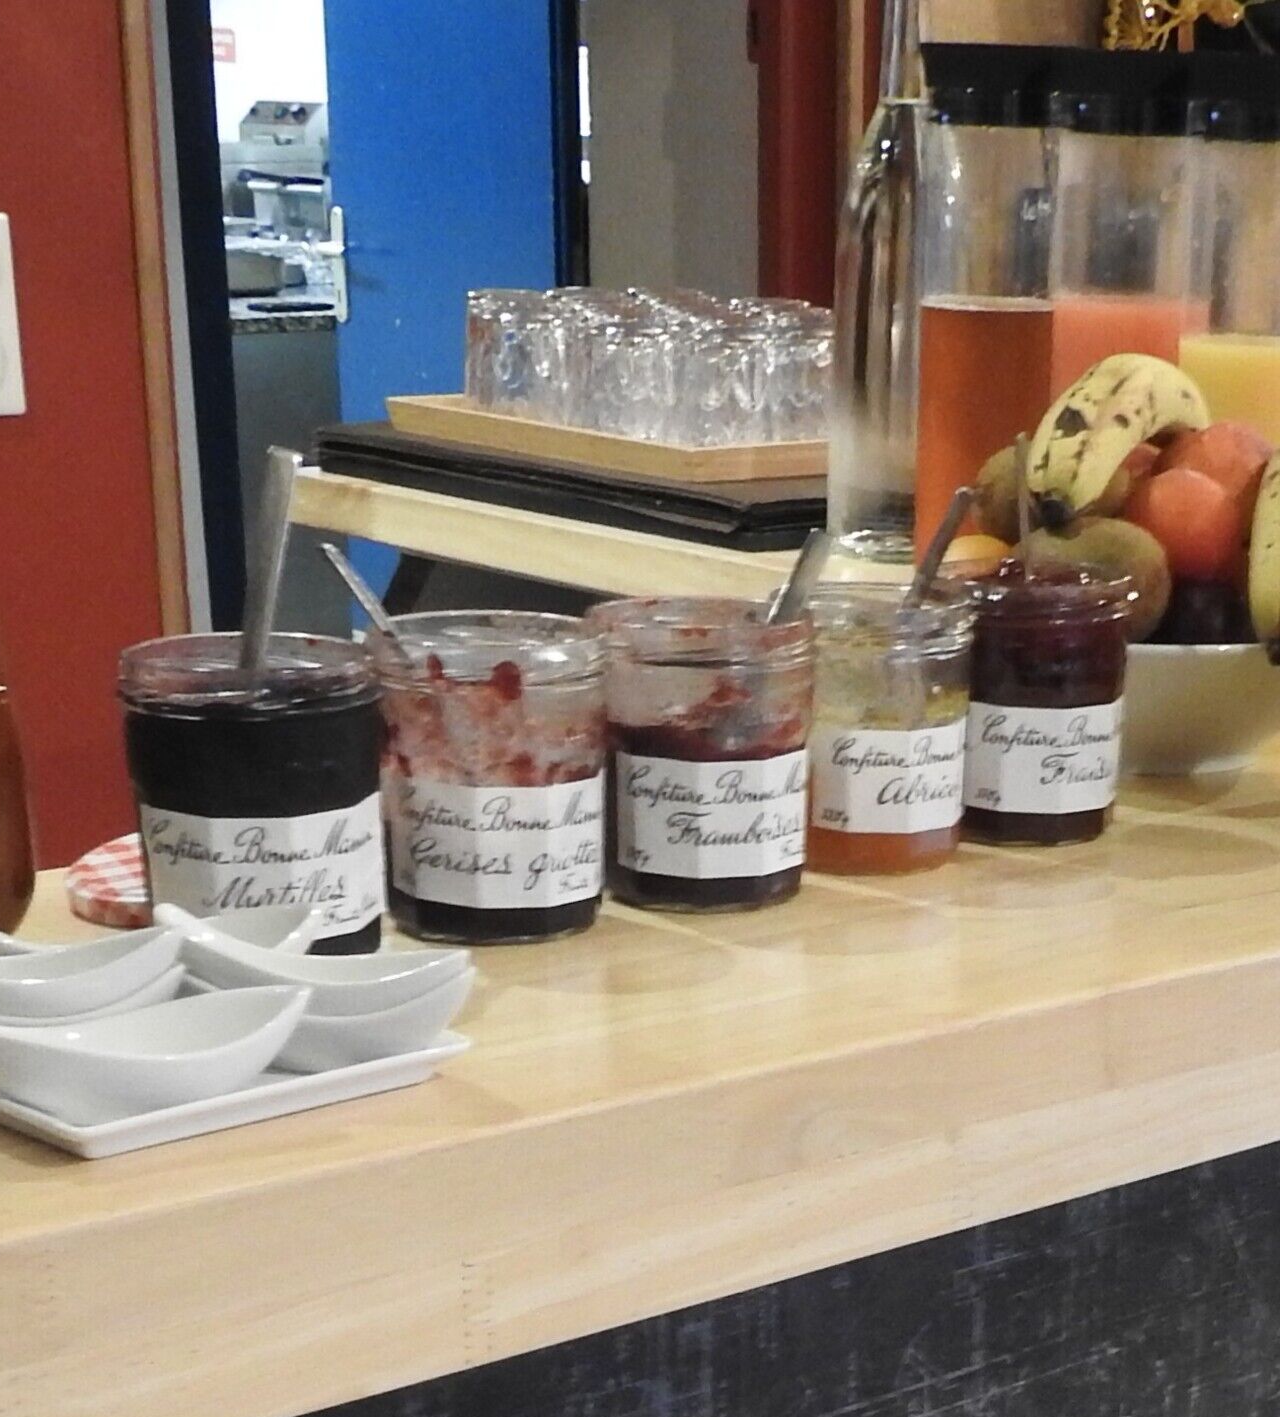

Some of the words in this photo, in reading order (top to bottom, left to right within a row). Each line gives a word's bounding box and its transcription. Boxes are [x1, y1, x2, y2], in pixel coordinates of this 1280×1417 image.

[981, 714, 1062, 753] Confiture
[831, 736, 910, 775] Confiture
[1039, 752, 1110, 785] Frais
[626, 765, 712, 808] Confiture
[714, 770, 777, 805] Bonne
[478, 796, 555, 832] Bonne
[232, 826, 312, 865] Bonne
[411, 837, 513, 874] Cerises
